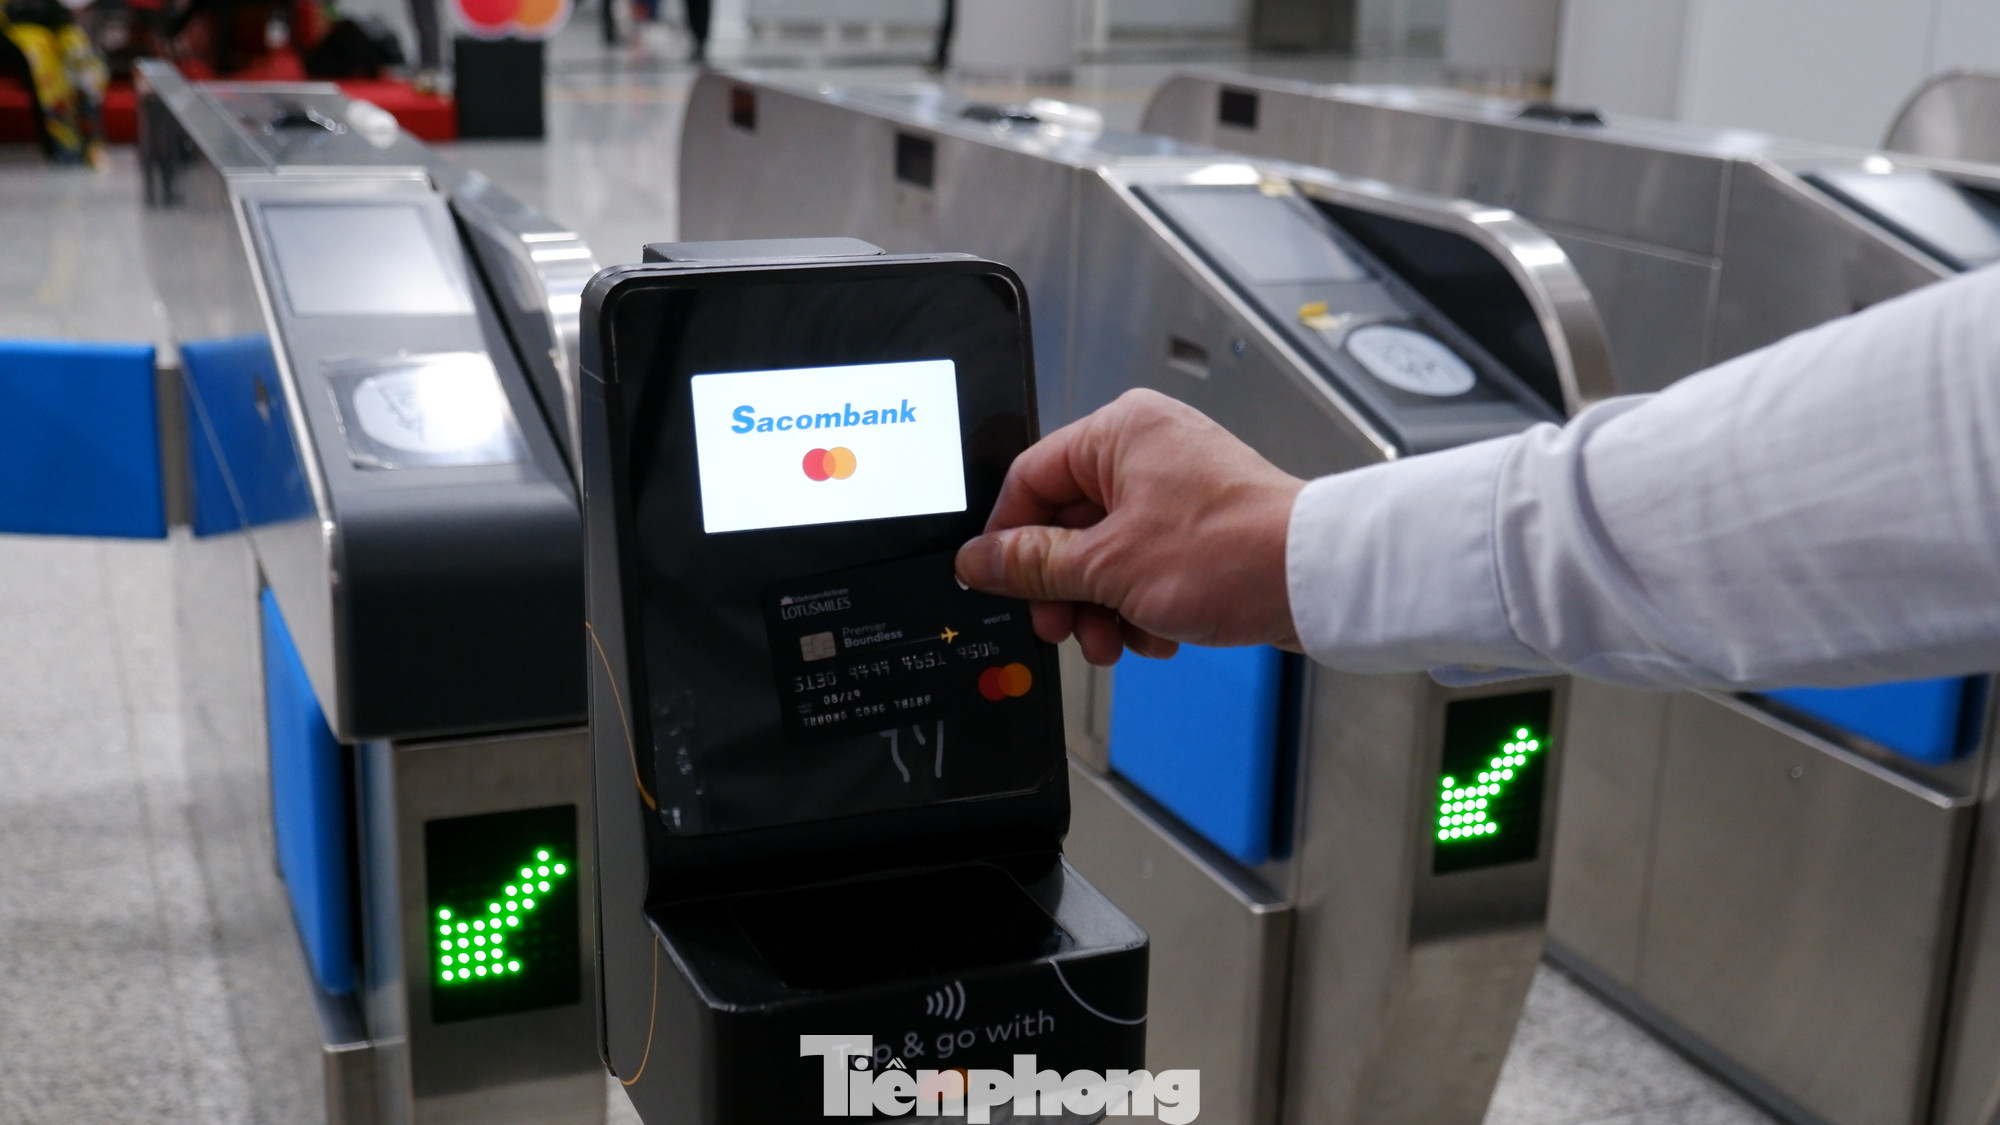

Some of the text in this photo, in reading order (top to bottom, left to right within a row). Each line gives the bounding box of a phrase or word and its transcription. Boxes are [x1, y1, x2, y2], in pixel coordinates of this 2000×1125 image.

[731, 399, 917, 434] Sacombank
[781, 596, 851, 620] LOTUSMILES
[983, 612, 1011, 625] world
[842, 622, 886, 637] Premier
[844, 630, 904, 648] Boundless
[793, 671, 837, 693] 5130
[903, 1031, 925, 1058] &
[937, 1028, 976, 1059] go
[986, 1010, 1055, 1044] with
